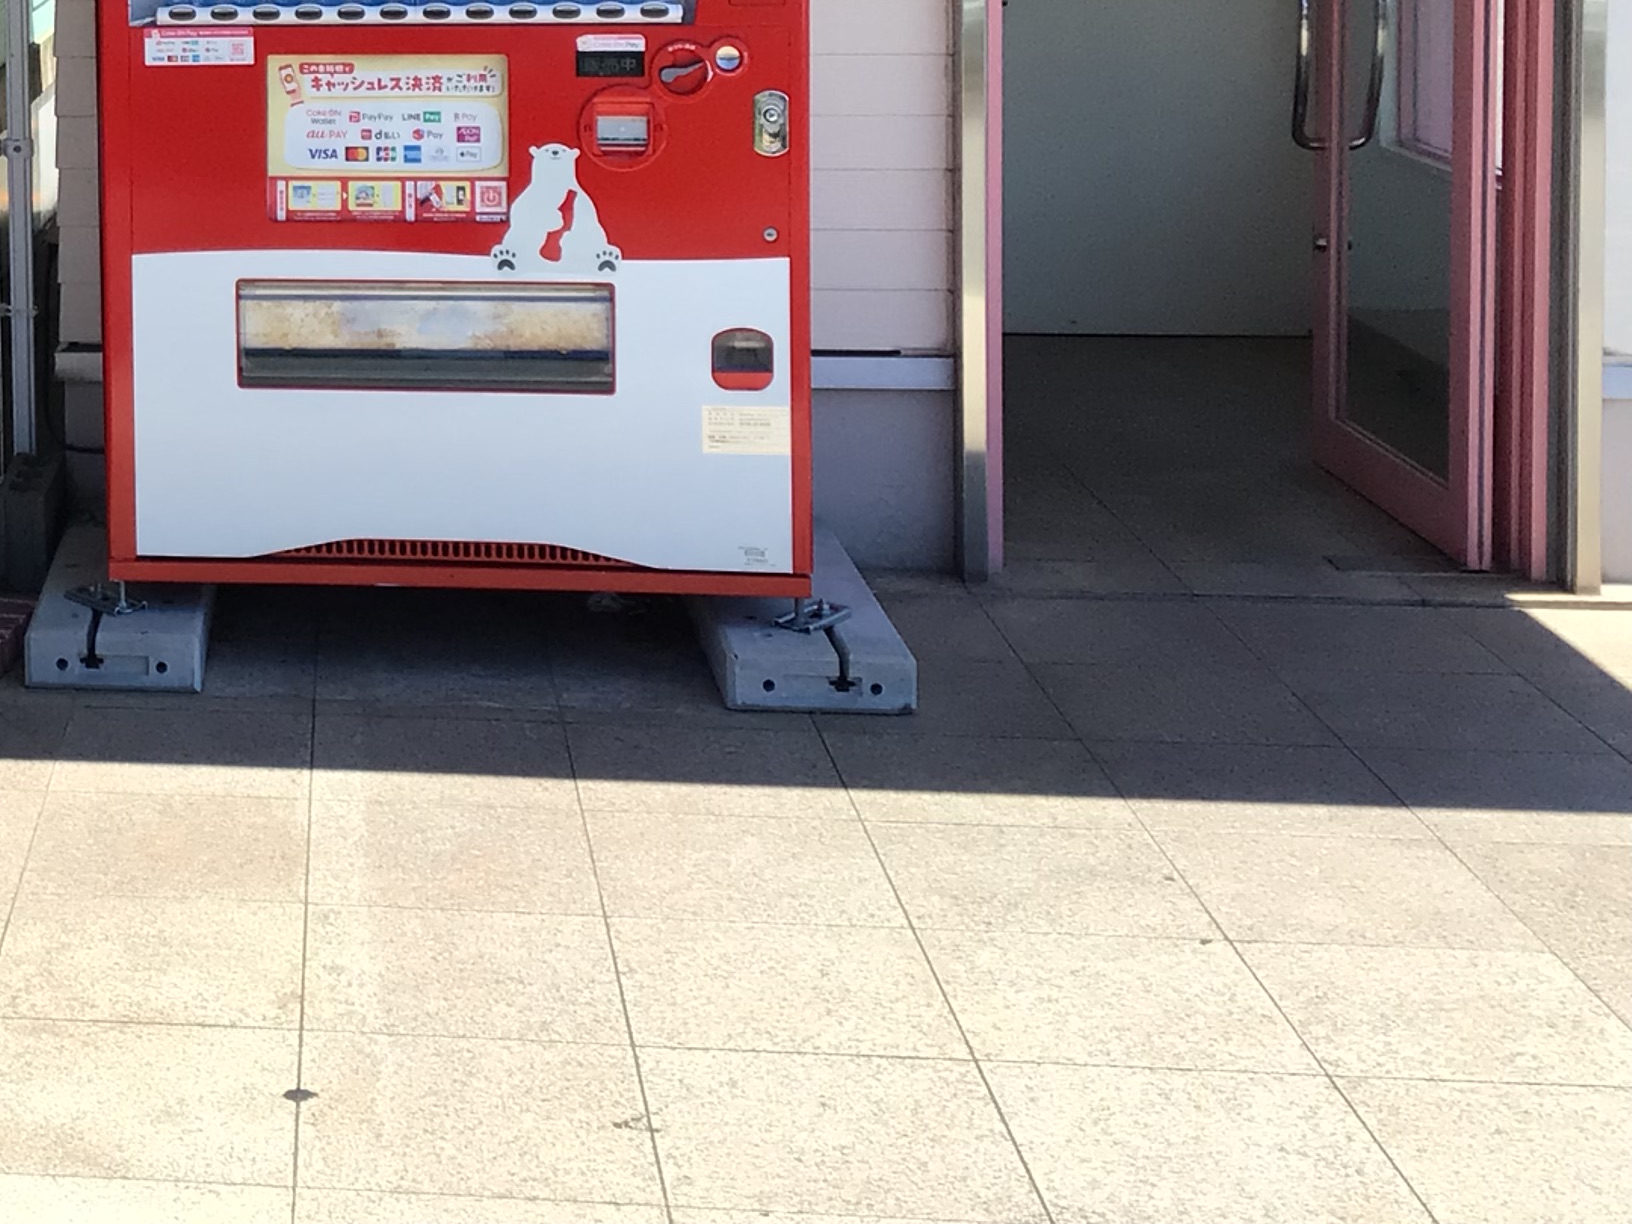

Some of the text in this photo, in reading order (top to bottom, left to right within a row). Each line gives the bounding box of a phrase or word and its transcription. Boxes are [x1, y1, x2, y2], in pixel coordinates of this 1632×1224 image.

[311, 75, 443, 92] キャッシュレス決済
[362, 112, 393, 122] PayPay
[402, 113, 421, 121] LINE
[427, 130, 444, 140] Pay
[308, 148, 339, 160] VISA
